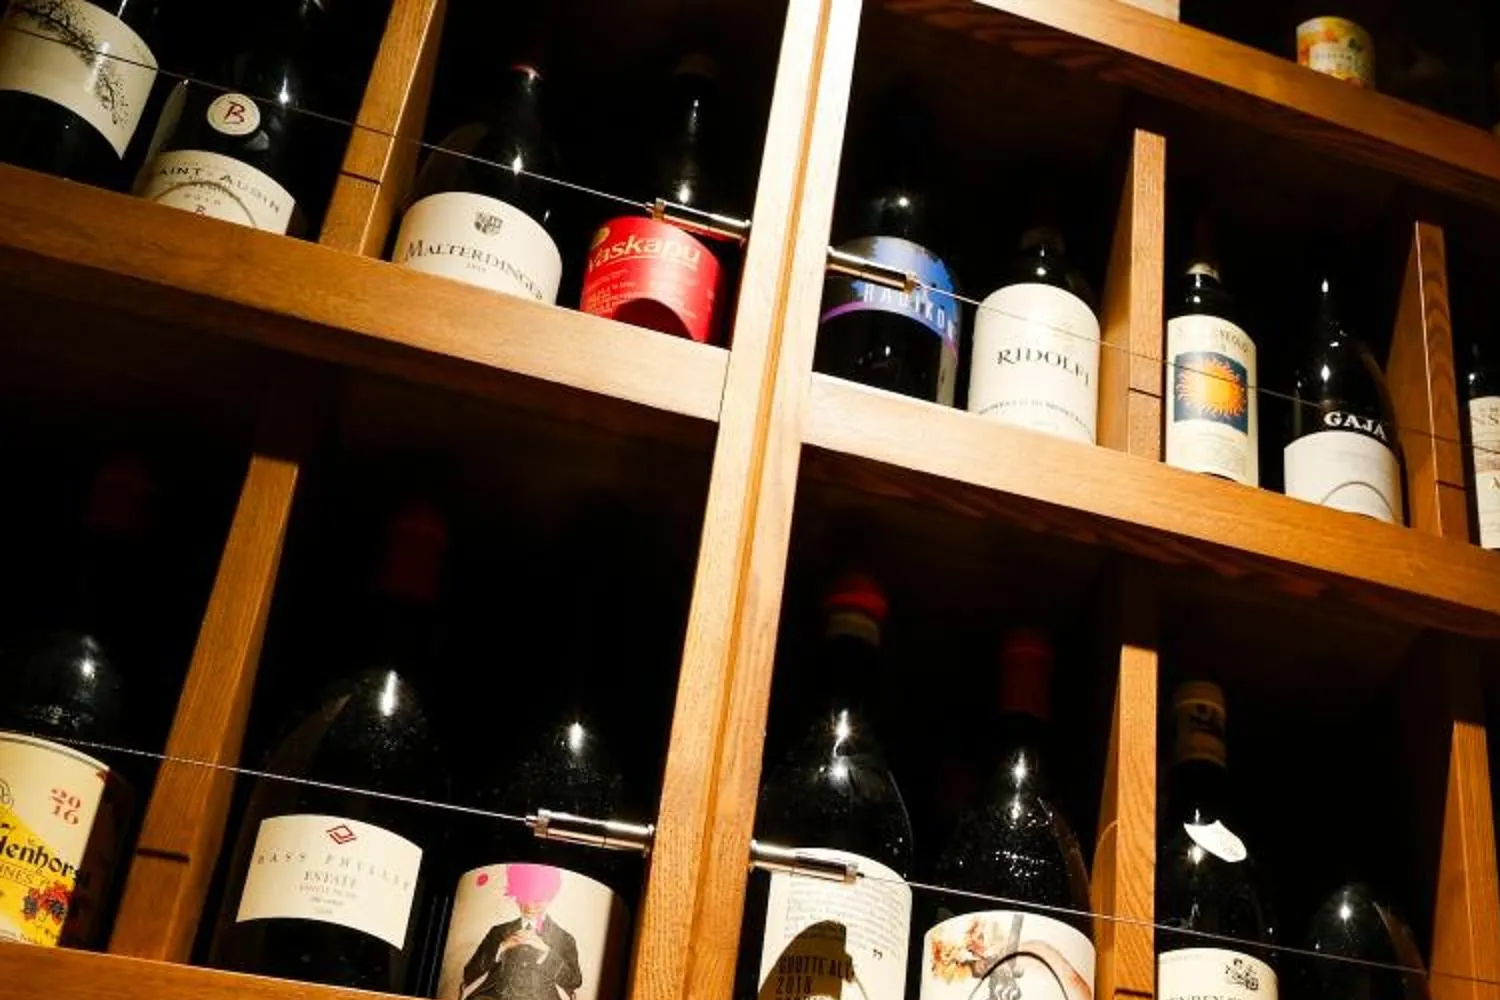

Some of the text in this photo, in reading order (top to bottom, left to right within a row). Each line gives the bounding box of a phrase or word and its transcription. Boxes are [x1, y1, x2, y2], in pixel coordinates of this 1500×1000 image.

[223, 101, 247, 124] B
[996, 347, 1091, 386] RIDOLFI
[1323, 410, 1388, 442] GAJA
[51, 787, 82, 809] 20
